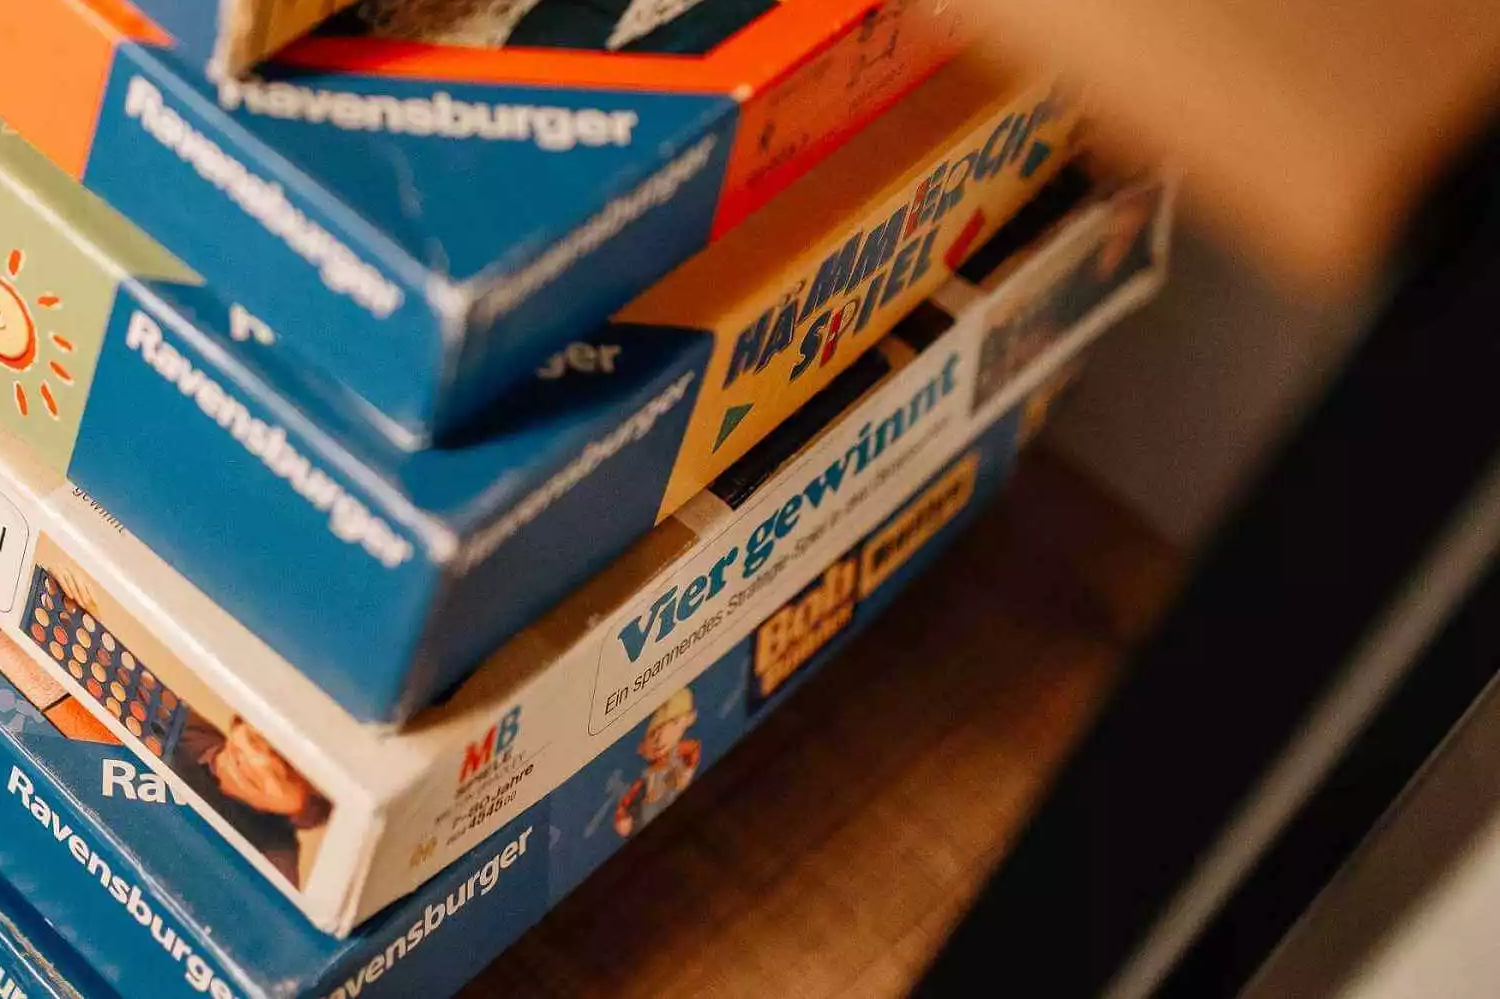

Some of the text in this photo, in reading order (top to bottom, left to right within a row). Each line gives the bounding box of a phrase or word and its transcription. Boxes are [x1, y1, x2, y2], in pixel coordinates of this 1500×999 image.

[124, 75, 405, 319] Ravensburger
[789, 228, 940, 382] SPIEL
[125, 310, 414, 570] Ravensburger
[617, 545, 739, 664] Vier
[741, 354, 959, 580] gewinnt
[604, 686, 629, 717] Ein
[632, 610, 724, 693] spannendes
[6, 765, 240, 999] Ravensburge
